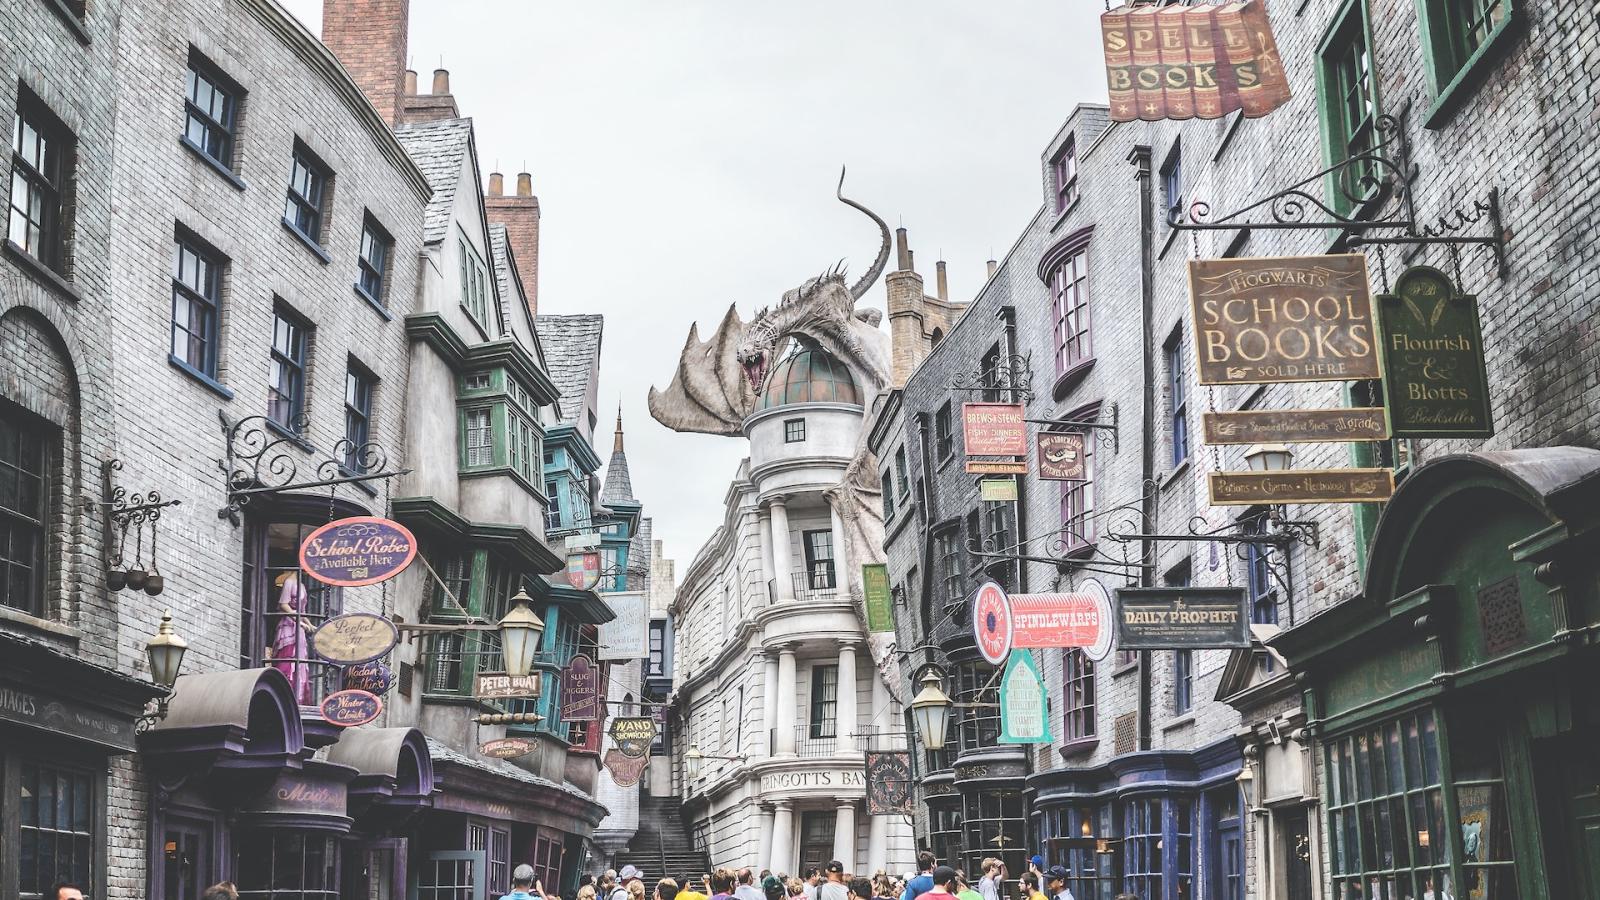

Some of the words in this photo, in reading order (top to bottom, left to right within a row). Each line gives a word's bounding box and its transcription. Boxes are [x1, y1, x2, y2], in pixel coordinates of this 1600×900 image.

[1107, 28, 1243, 50] SPELL
[1109, 65, 1257, 90] BOOKS
[1234, 271, 1325, 290] HOGWARTS
[1203, 295, 1364, 325] SCHOOL
[1204, 325, 1370, 363] BOOKS
[1392, 334, 1470, 351] Flourish
[1258, 365, 1298, 378] SOLD
[1305, 363, 1348, 376] HERE
[1422, 357, 1450, 380] &
[1408, 383, 1469, 401] Blotts
[967, 413, 992, 424] BREWS
[998, 413, 1021, 424] STEWS
[968, 429, 988, 437] FISHY
[991, 429, 1022, 438] DINNERS
[1218, 479, 1250, 496] Potions
[1261, 478, 1293, 495] Charms
[307, 538, 363, 557] School
[361, 536, 409, 554] Robes
[320, 555, 367, 569] Available
[370, 555, 393, 566] Here
[1015, 612, 1097, 628] SPINDLEWARPS
[1124, 611, 1168, 624] DAILY
[1169, 610, 1238, 624] PROPHET
[334, 620, 376, 634] Perfect
[345, 636, 362, 645] Fit
[480, 676, 510, 694] PETER
[338, 696, 365, 708] Winter
[616, 721, 651, 731] WAND
[616, 731, 651, 740] SHOWROOM
[762, 771, 831, 791] GRINGOTTS
[842, 772, 867, 786] BAN
